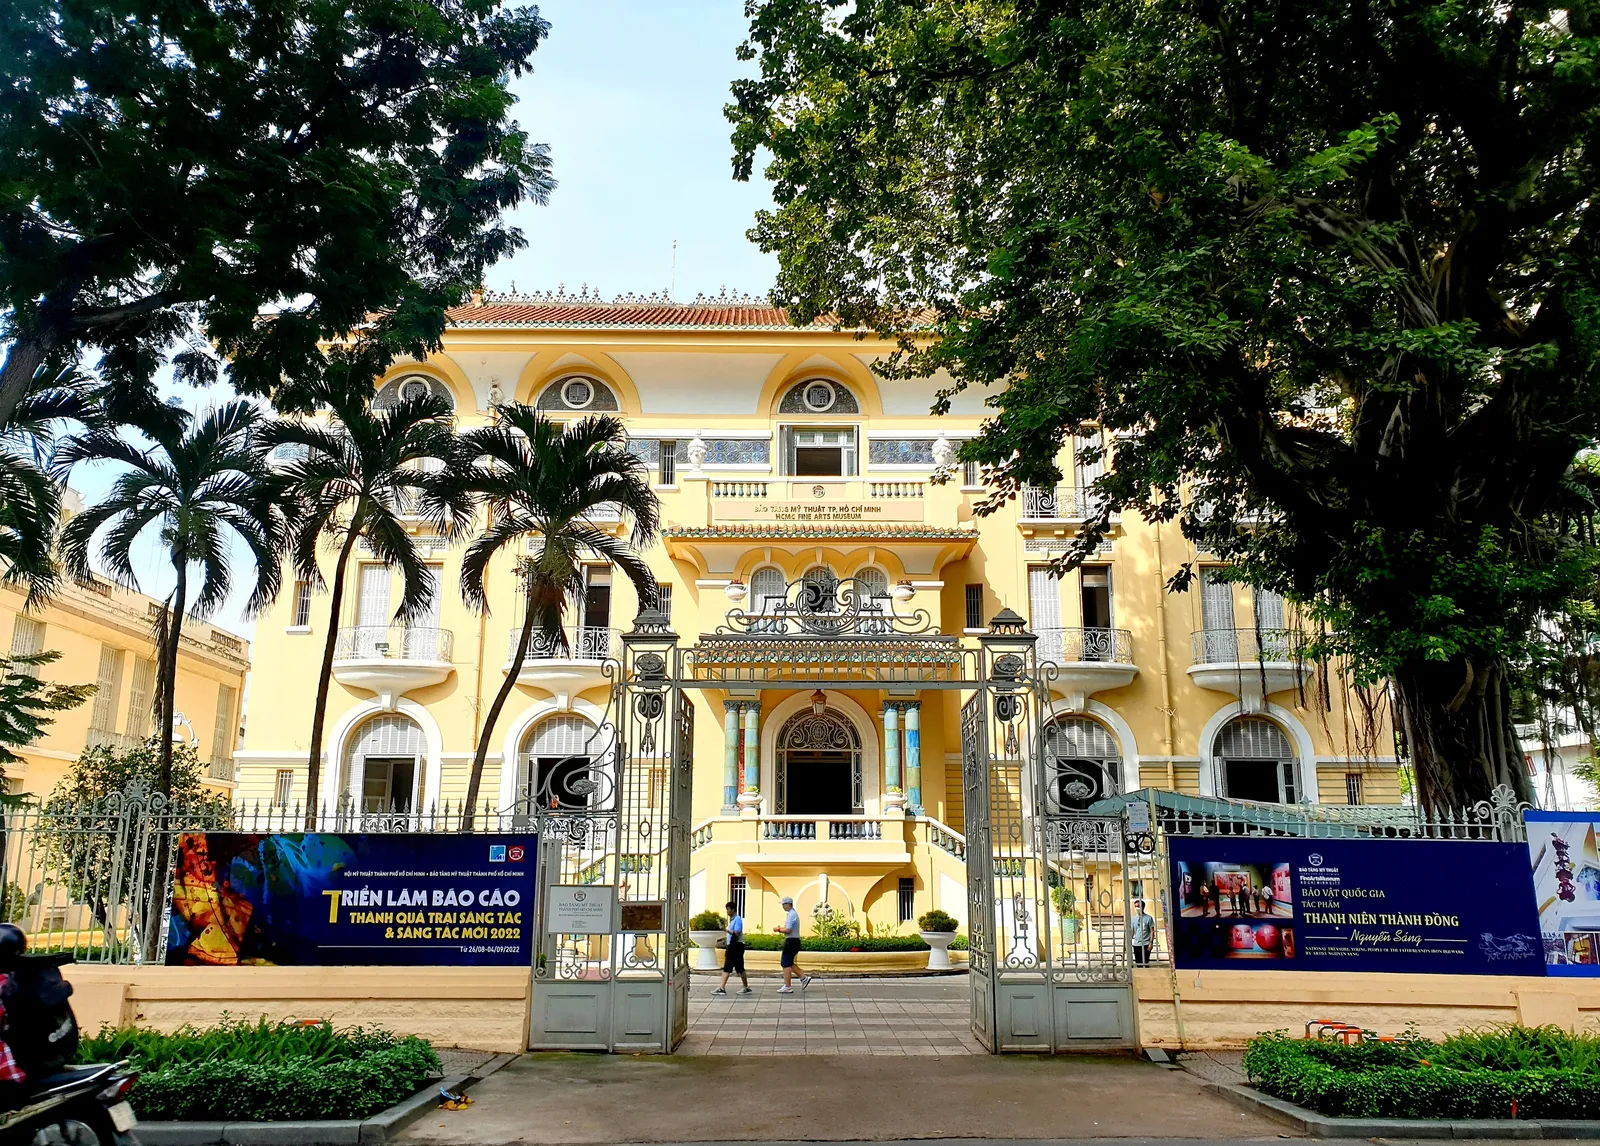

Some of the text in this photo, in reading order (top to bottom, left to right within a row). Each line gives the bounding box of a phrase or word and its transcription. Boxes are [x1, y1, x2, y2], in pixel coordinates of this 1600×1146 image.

[790, 504, 801, 513] MỸ
[803, 504, 826, 514] THUẬT
[851, 504, 863, 513] CHÍ
[1301, 887, 1386, 899] BẢO VẬT QUỐC GIA
[322, 885, 521, 923] TRIỂN LÃM BÁO CÁO
[1301, 900, 1316, 908] TÁC
[349, 910, 522, 925] THÀNH QUẢ TRẠI SÁNG TÁC
[1303, 911, 1460, 927] THANH NIÊN THÀNH ĐỒNG
[385, 926, 520, 939] & SÁNG TÁC MỚI 2022
[1350, 929, 1423, 947] Nguyễn Sáng
